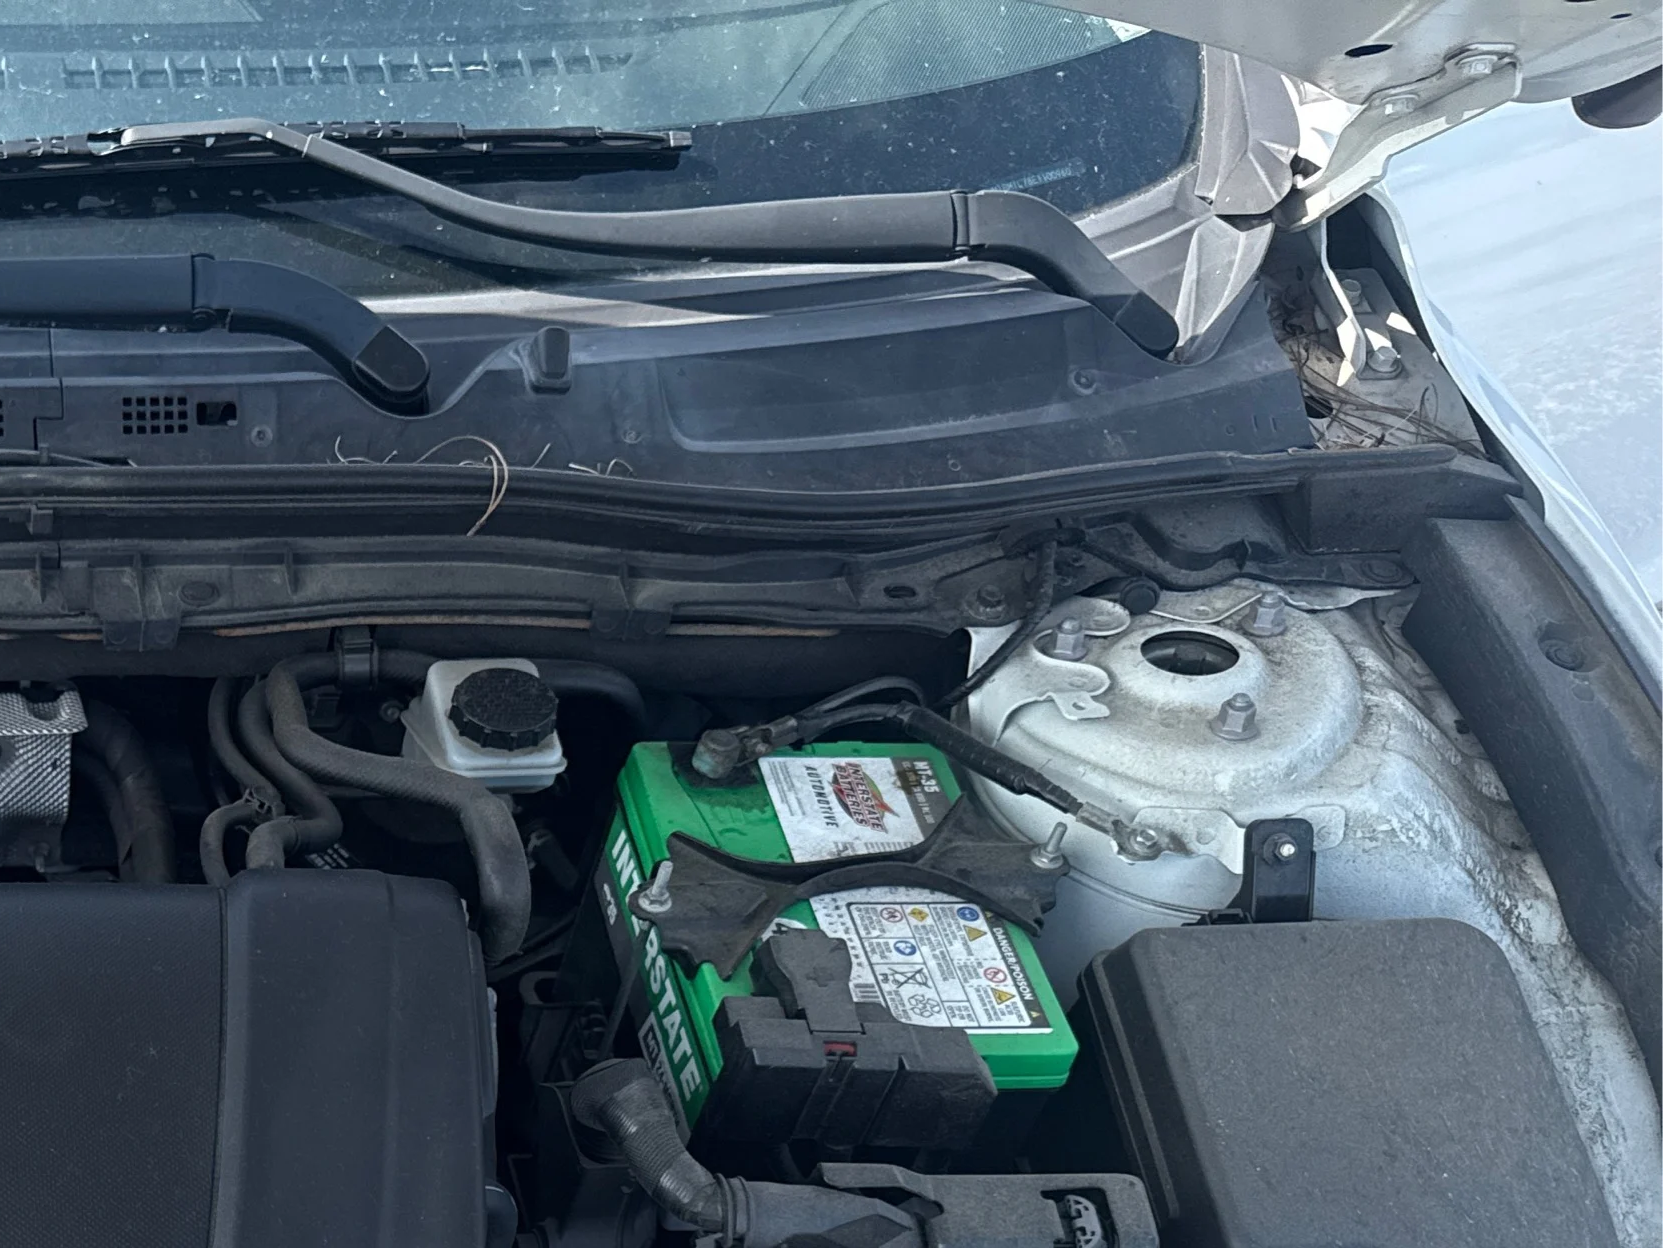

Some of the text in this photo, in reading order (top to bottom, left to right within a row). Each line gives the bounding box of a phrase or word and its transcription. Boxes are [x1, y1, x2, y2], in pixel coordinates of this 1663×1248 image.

[804, 765, 839, 828] AUTOMOTIVE
[835, 765, 868, 826] BATTERIES
[846, 761, 884, 831] INTERSTATE
[913, 760, 940, 794] MT-35
[992, 926, 1034, 1001] DANGER/POISON
